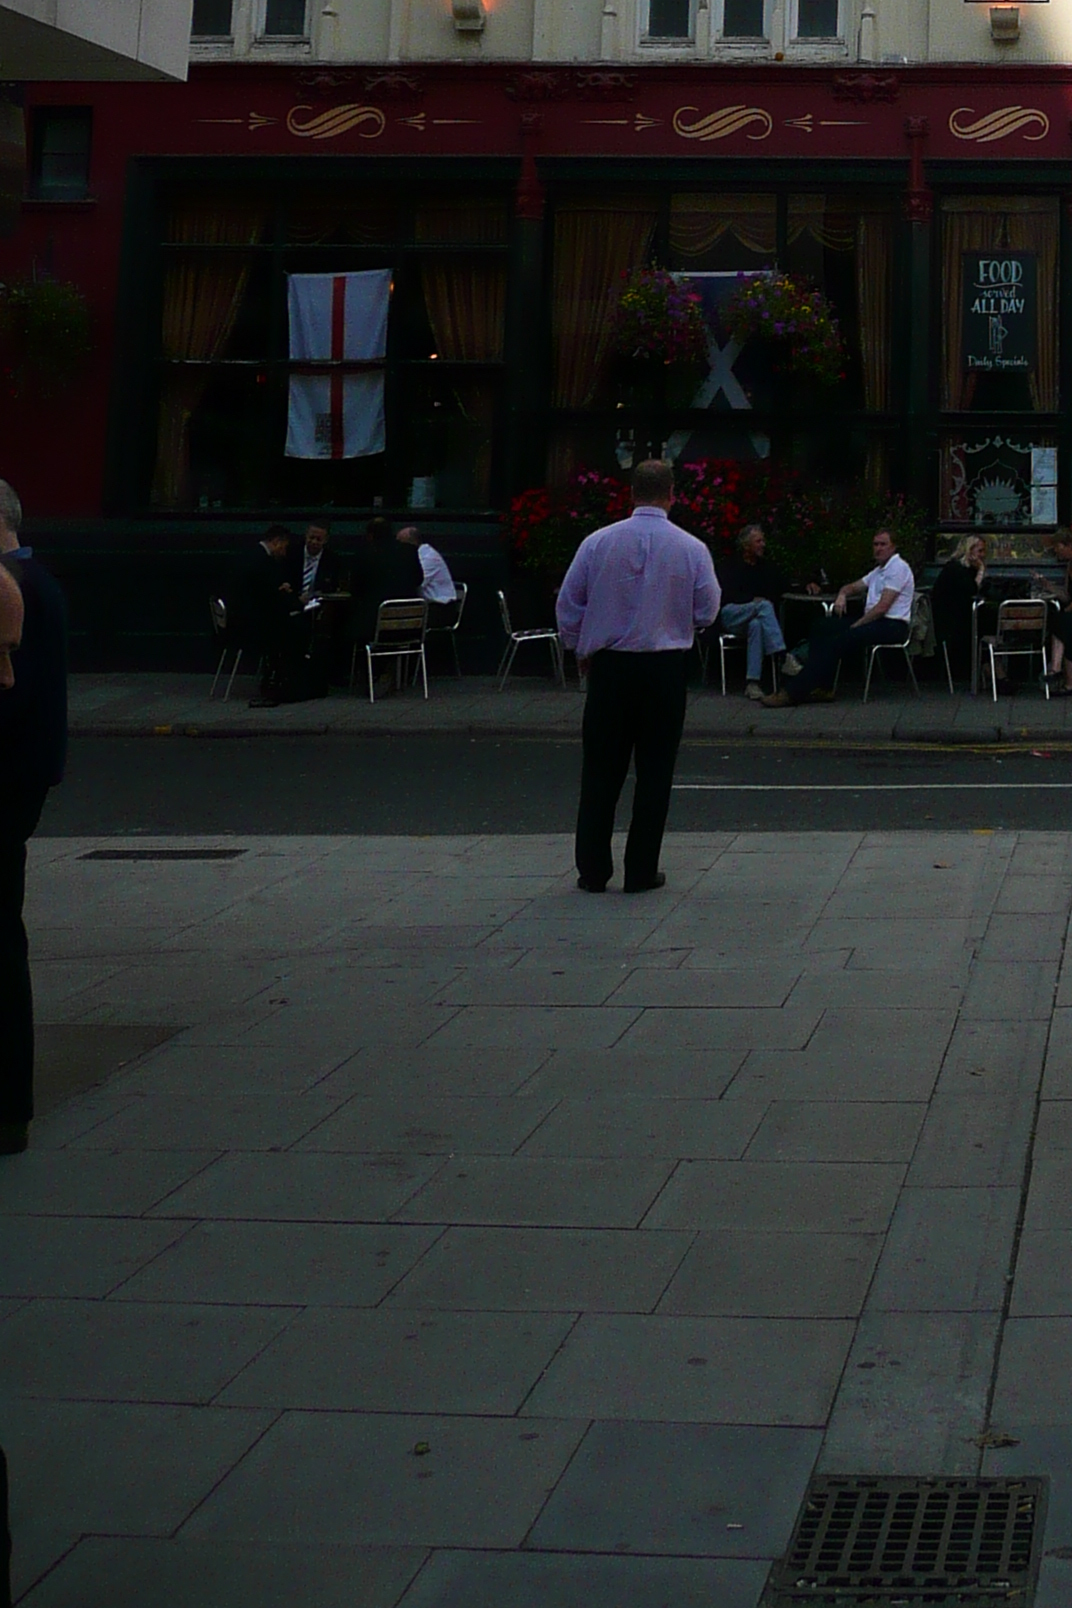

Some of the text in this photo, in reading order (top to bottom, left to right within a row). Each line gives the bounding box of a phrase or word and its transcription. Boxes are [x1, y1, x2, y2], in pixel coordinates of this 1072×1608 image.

[978, 260, 1023, 283] FOOD
[983, 285, 1017, 298] served
[970, 298, 1025, 314] ALL DAY
[967, 355, 1029, 371] Daily Specials
